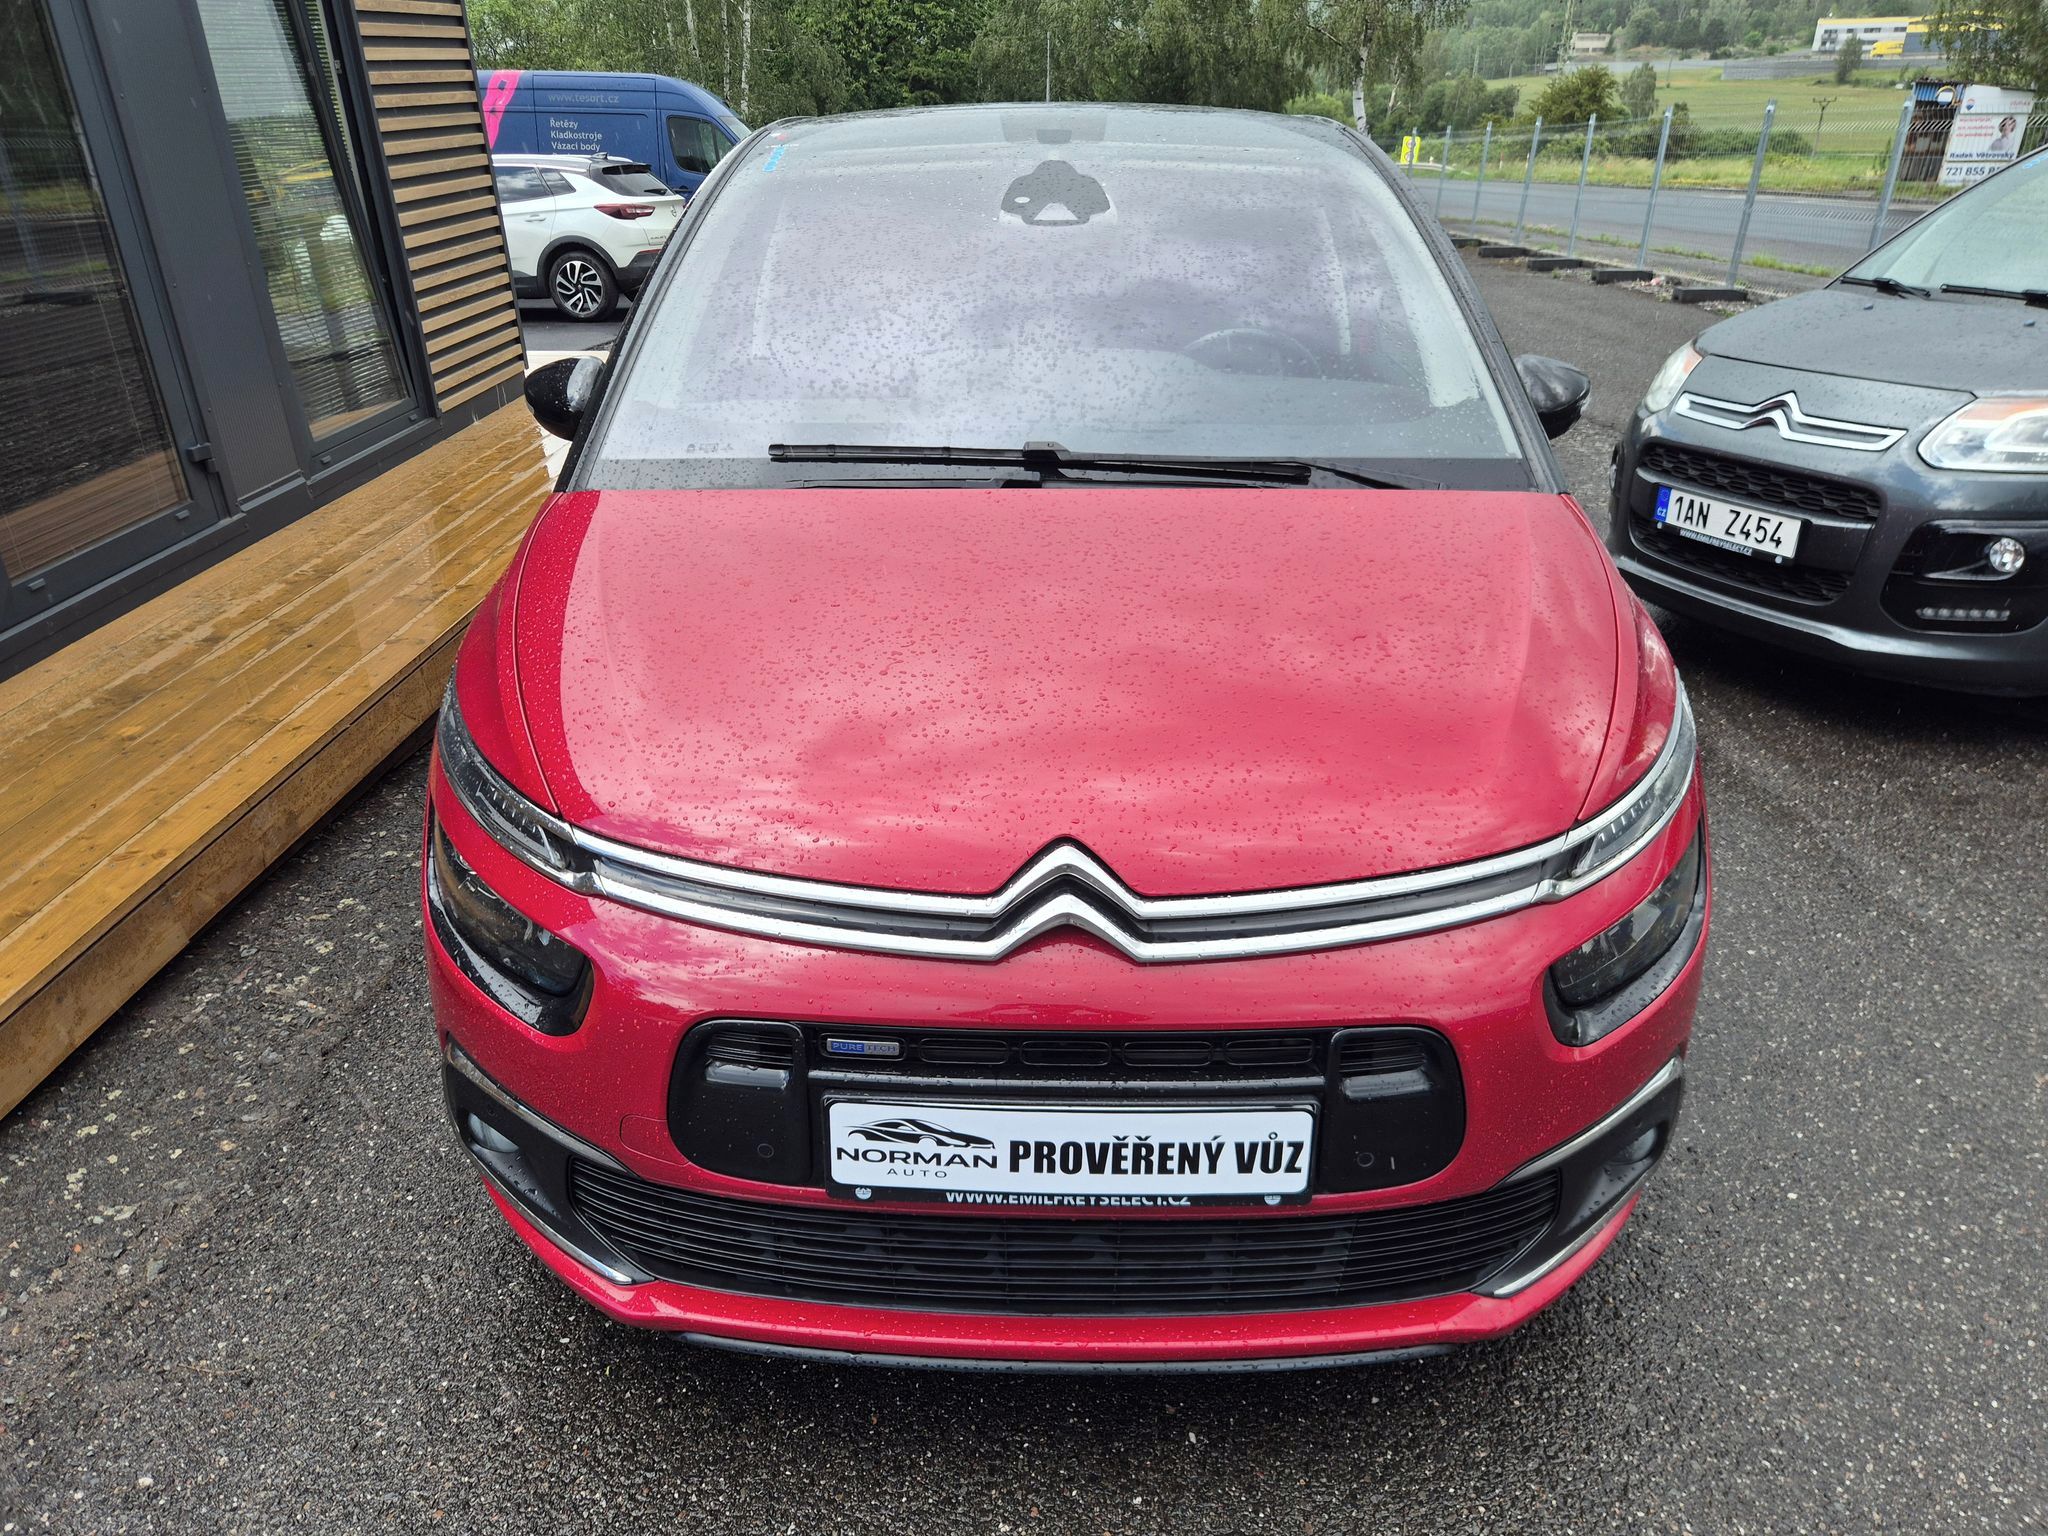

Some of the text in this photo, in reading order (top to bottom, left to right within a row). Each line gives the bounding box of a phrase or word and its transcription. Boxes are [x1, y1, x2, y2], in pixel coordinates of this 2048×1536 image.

[548, 94, 619, 103] www.tesort.cz
[550, 117, 578, 129] Řetězy
[550, 130, 602, 141] Kladkostroje
[551, 142, 601, 152] Vázací body
[1946, 167, 1963, 176] 721
[1965, 167, 1985, 176] 855
[1656, 507, 1667, 516] CZ
[1675, 496, 1783, 549] 1AN Z454
[836, 1147, 998, 1169] NORMAN
[1009, 1131, 1304, 1175] PROVĚŘENÝ VŮZ
[887, 1168, 947, 1178] AUTO
